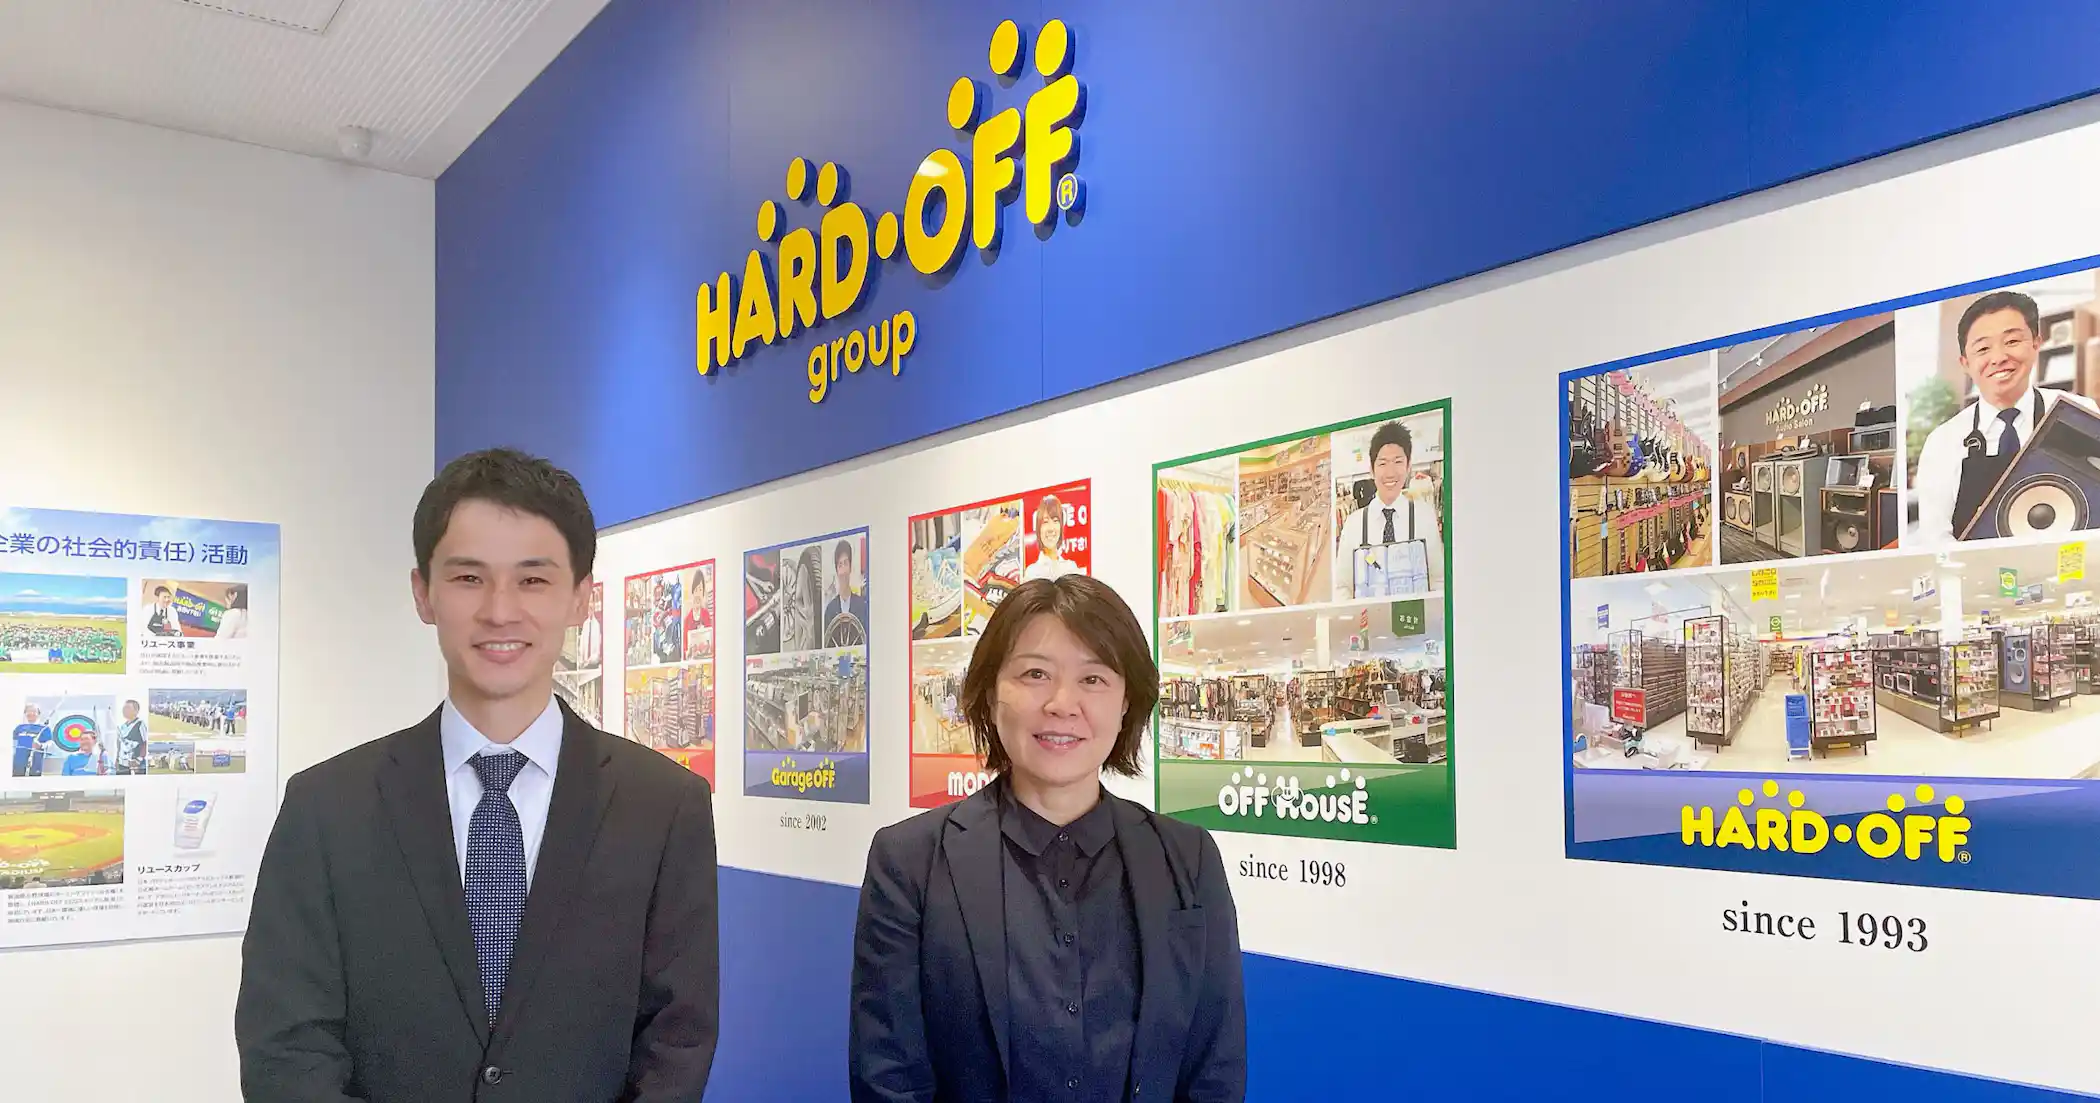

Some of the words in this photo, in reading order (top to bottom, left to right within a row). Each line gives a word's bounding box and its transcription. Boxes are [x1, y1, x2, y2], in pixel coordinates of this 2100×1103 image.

[808, 310, 916, 403] group
[141, 640, 195, 649] リユース事業
[1218, 784, 1270, 818] OFF
[780, 811, 802, 828] since
[805, 814, 827, 831] 2002
[1239, 854, 1289, 881] since
[1300, 859, 1346, 887] 1998
[1722, 900, 1816, 940] since
[1838, 911, 1928, 952] 1993
